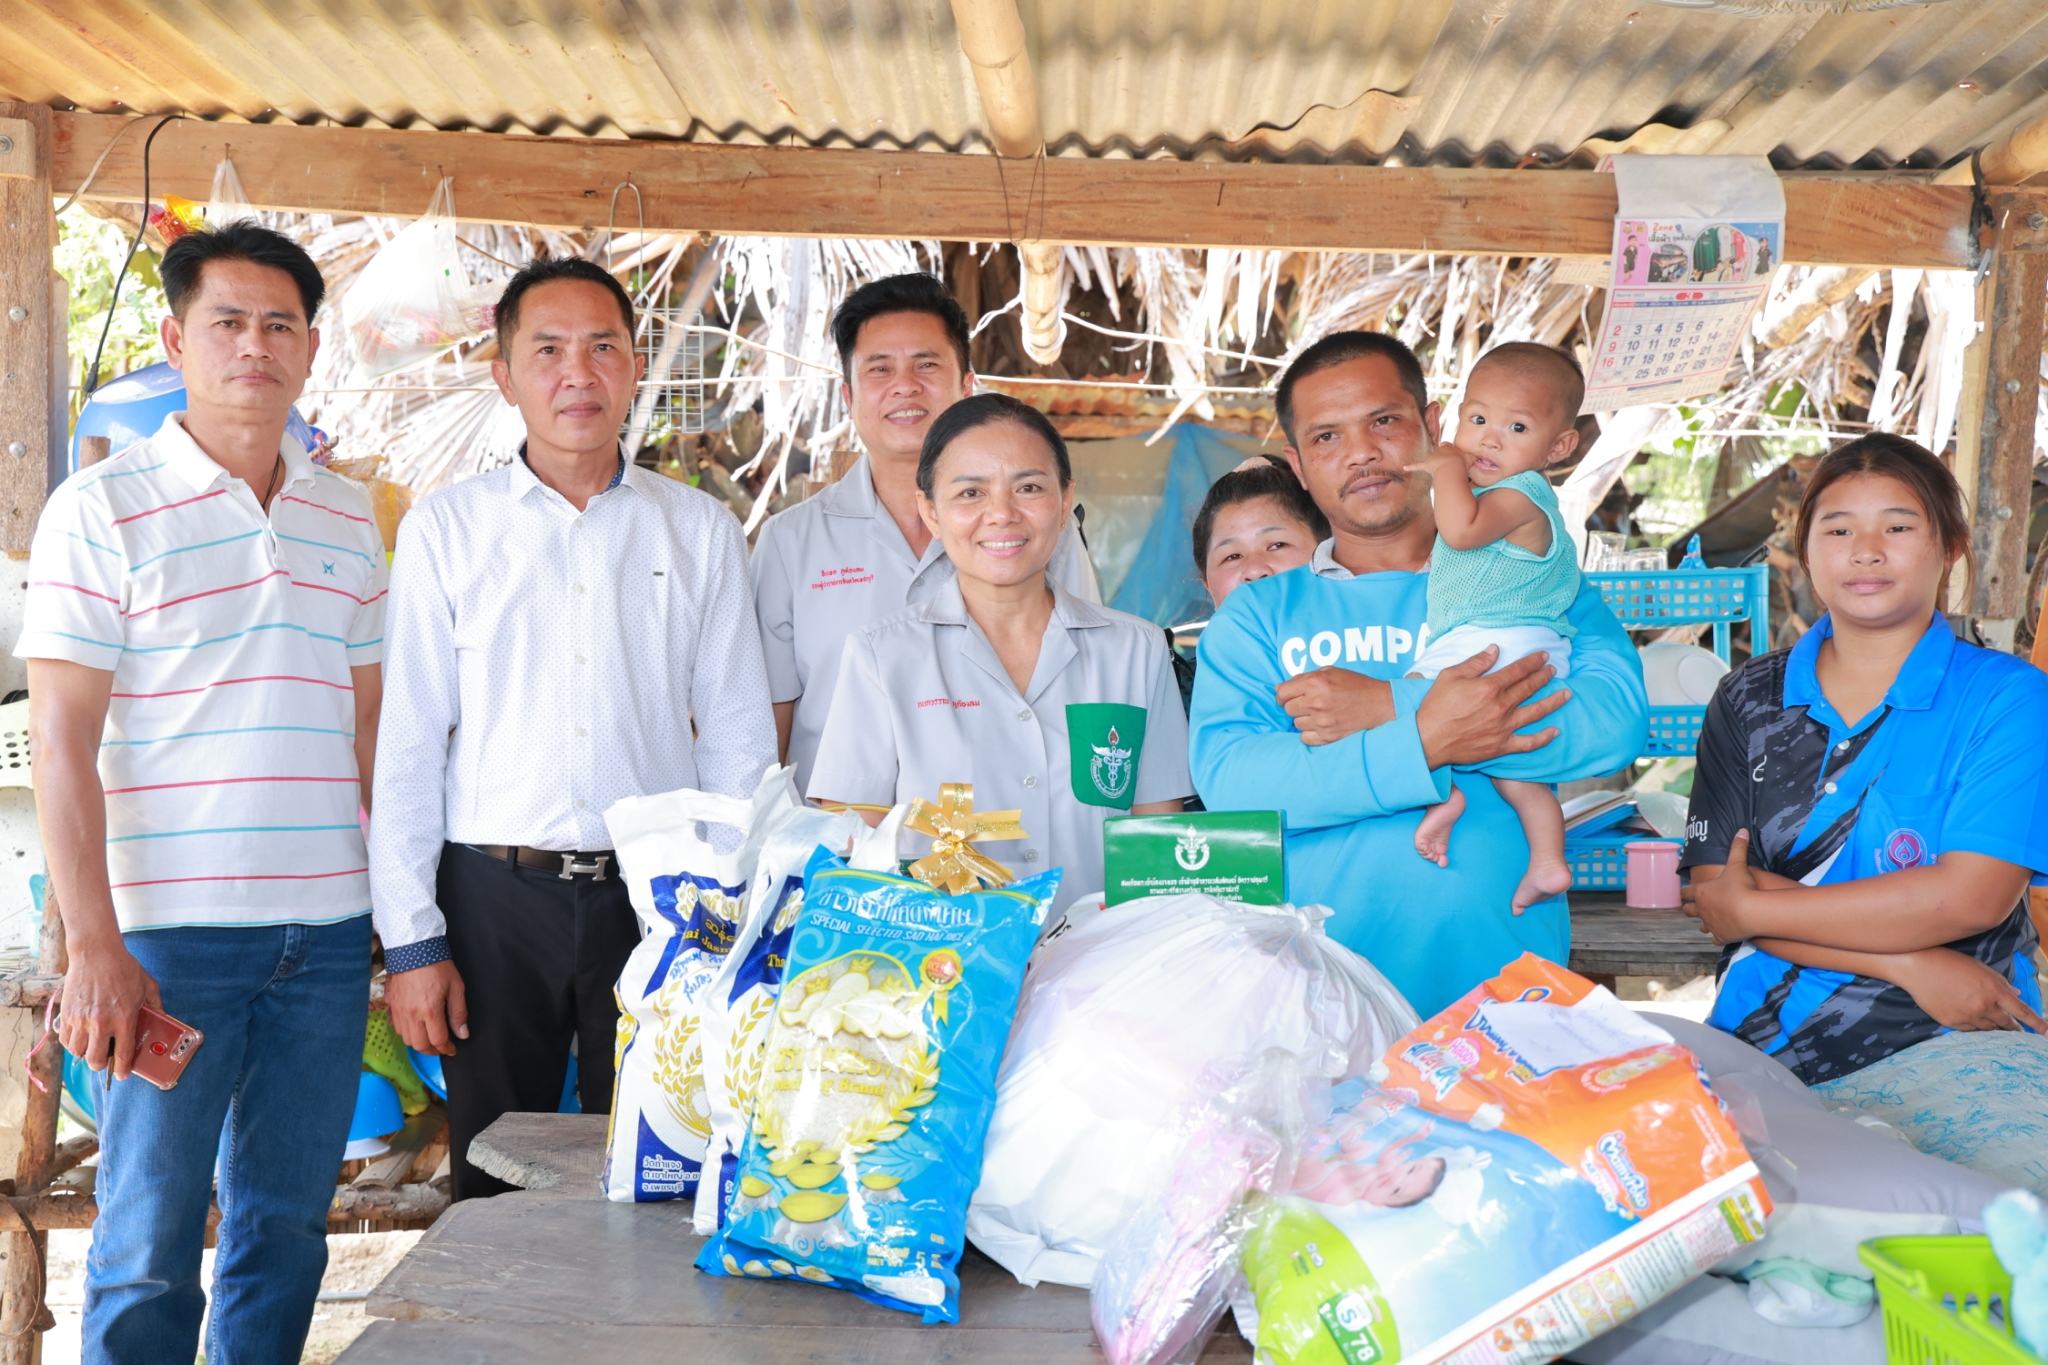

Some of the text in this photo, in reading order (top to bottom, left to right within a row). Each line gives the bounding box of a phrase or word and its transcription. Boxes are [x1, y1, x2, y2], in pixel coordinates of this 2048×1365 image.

[1652, 222, 1673, 231] Zone
[1685, 292, 1694, 300] 3
[1613, 325, 1622, 336] 2
[1634, 324, 1643, 335] 3
[1655, 323, 1663, 334] 4
[1675, 323, 1684, 332] 5
[1695, 321, 1705, 331] 6
[1715, 318, 1723, 327] 7
[1608, 328, 1737, 352] 9 10 11 12 13 14 15
[1601, 342, 1732, 368] 16 17 18 19 20 21 22
[1635, 369, 1649, 379] 25
[1654, 367, 1668, 377] 26
[1673, 363, 1687, 373] 27
[1692, 359, 1706, 370] 28
[1711, 356, 1725, 366] 29
[810, 913, 851, 934] SPECIAL
[854, 924, 901, 939] SELECTED
[926, 931, 944, 941] HAI
[1448, 1038, 1478, 1067] Happy
[839, 1078, 886, 1096] Brand
[643, 1155, 681, 1169] วัดถ้ำแจง
[643, 1170, 683, 1180] ต.เขาใหญ่
[643, 1182, 683, 1193] จ.เพชรบุรี
[916, 1250, 926, 1268] 5
[1340, 1309, 1357, 1325] S
[1350, 1332, 1375, 1362] 78
